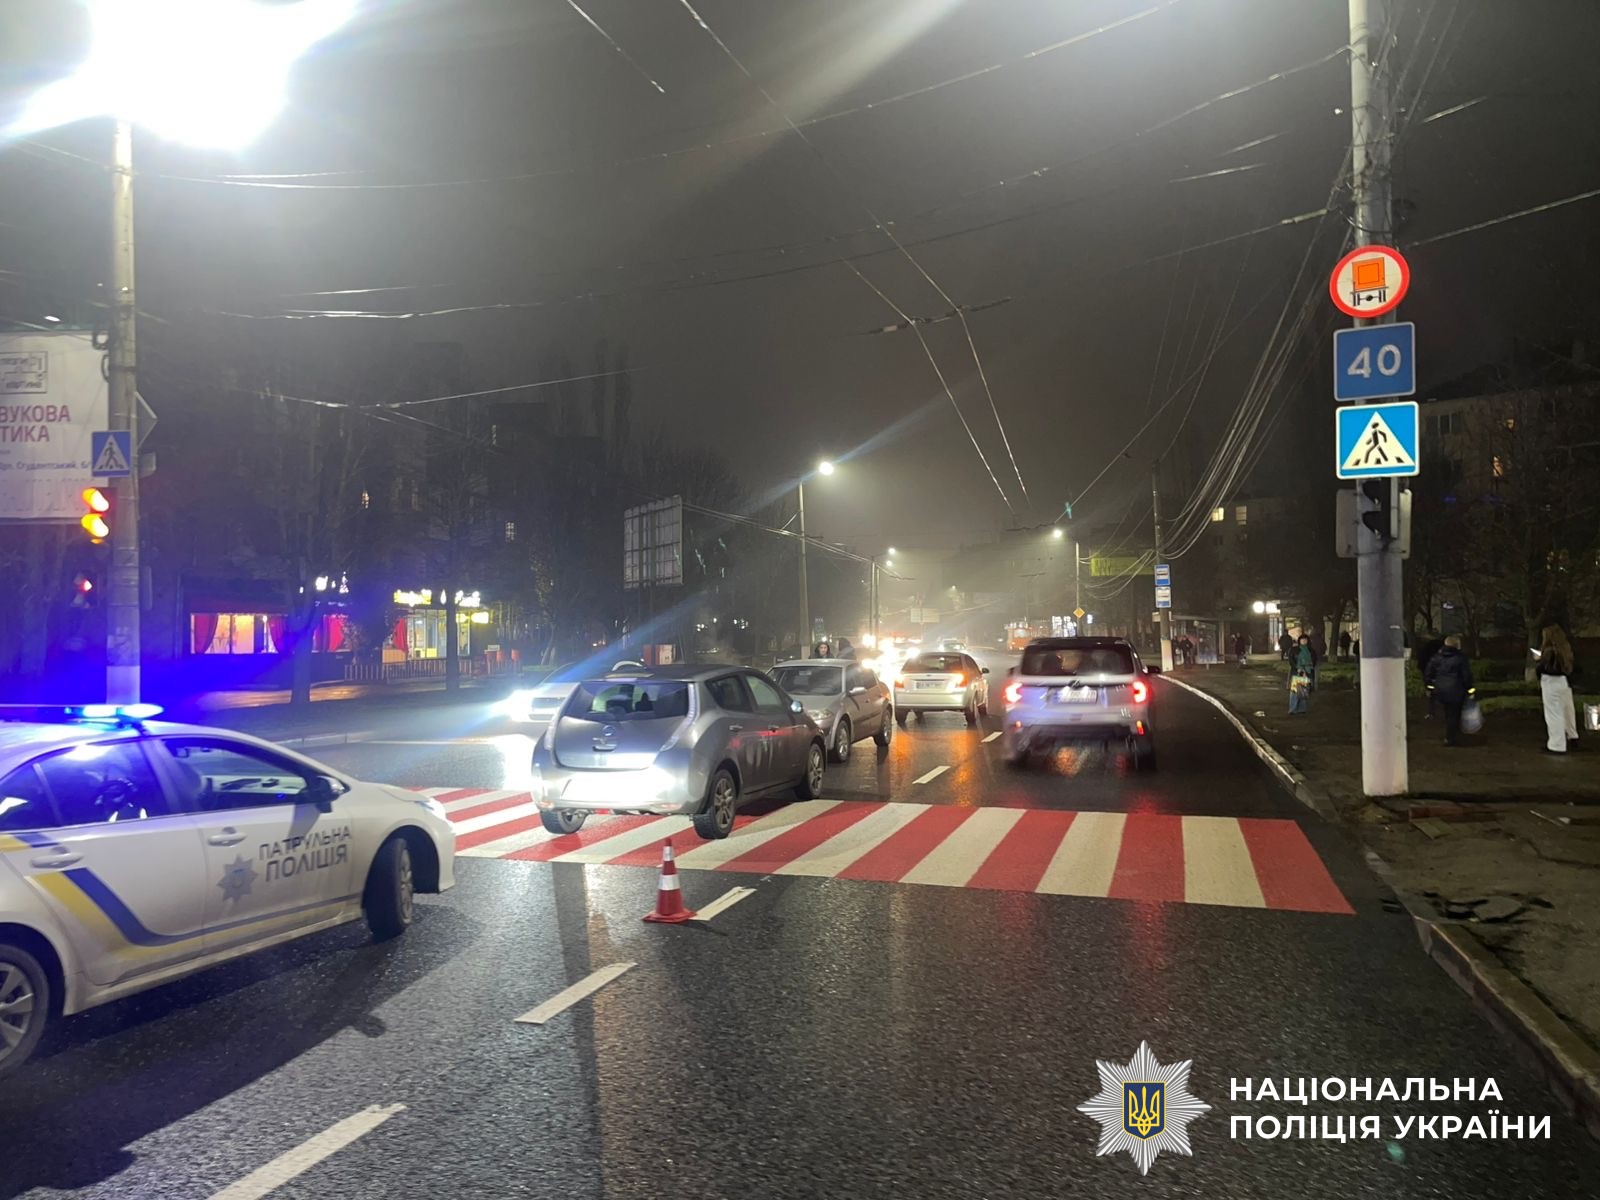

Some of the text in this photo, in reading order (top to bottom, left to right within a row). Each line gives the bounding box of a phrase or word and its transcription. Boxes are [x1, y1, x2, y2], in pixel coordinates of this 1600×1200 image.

[1347, 344, 1401, 378] 40
[258, 825, 351, 861] ПАТРУЛЬНА
[265, 843, 348, 882] ПОЛІЦІЯ
